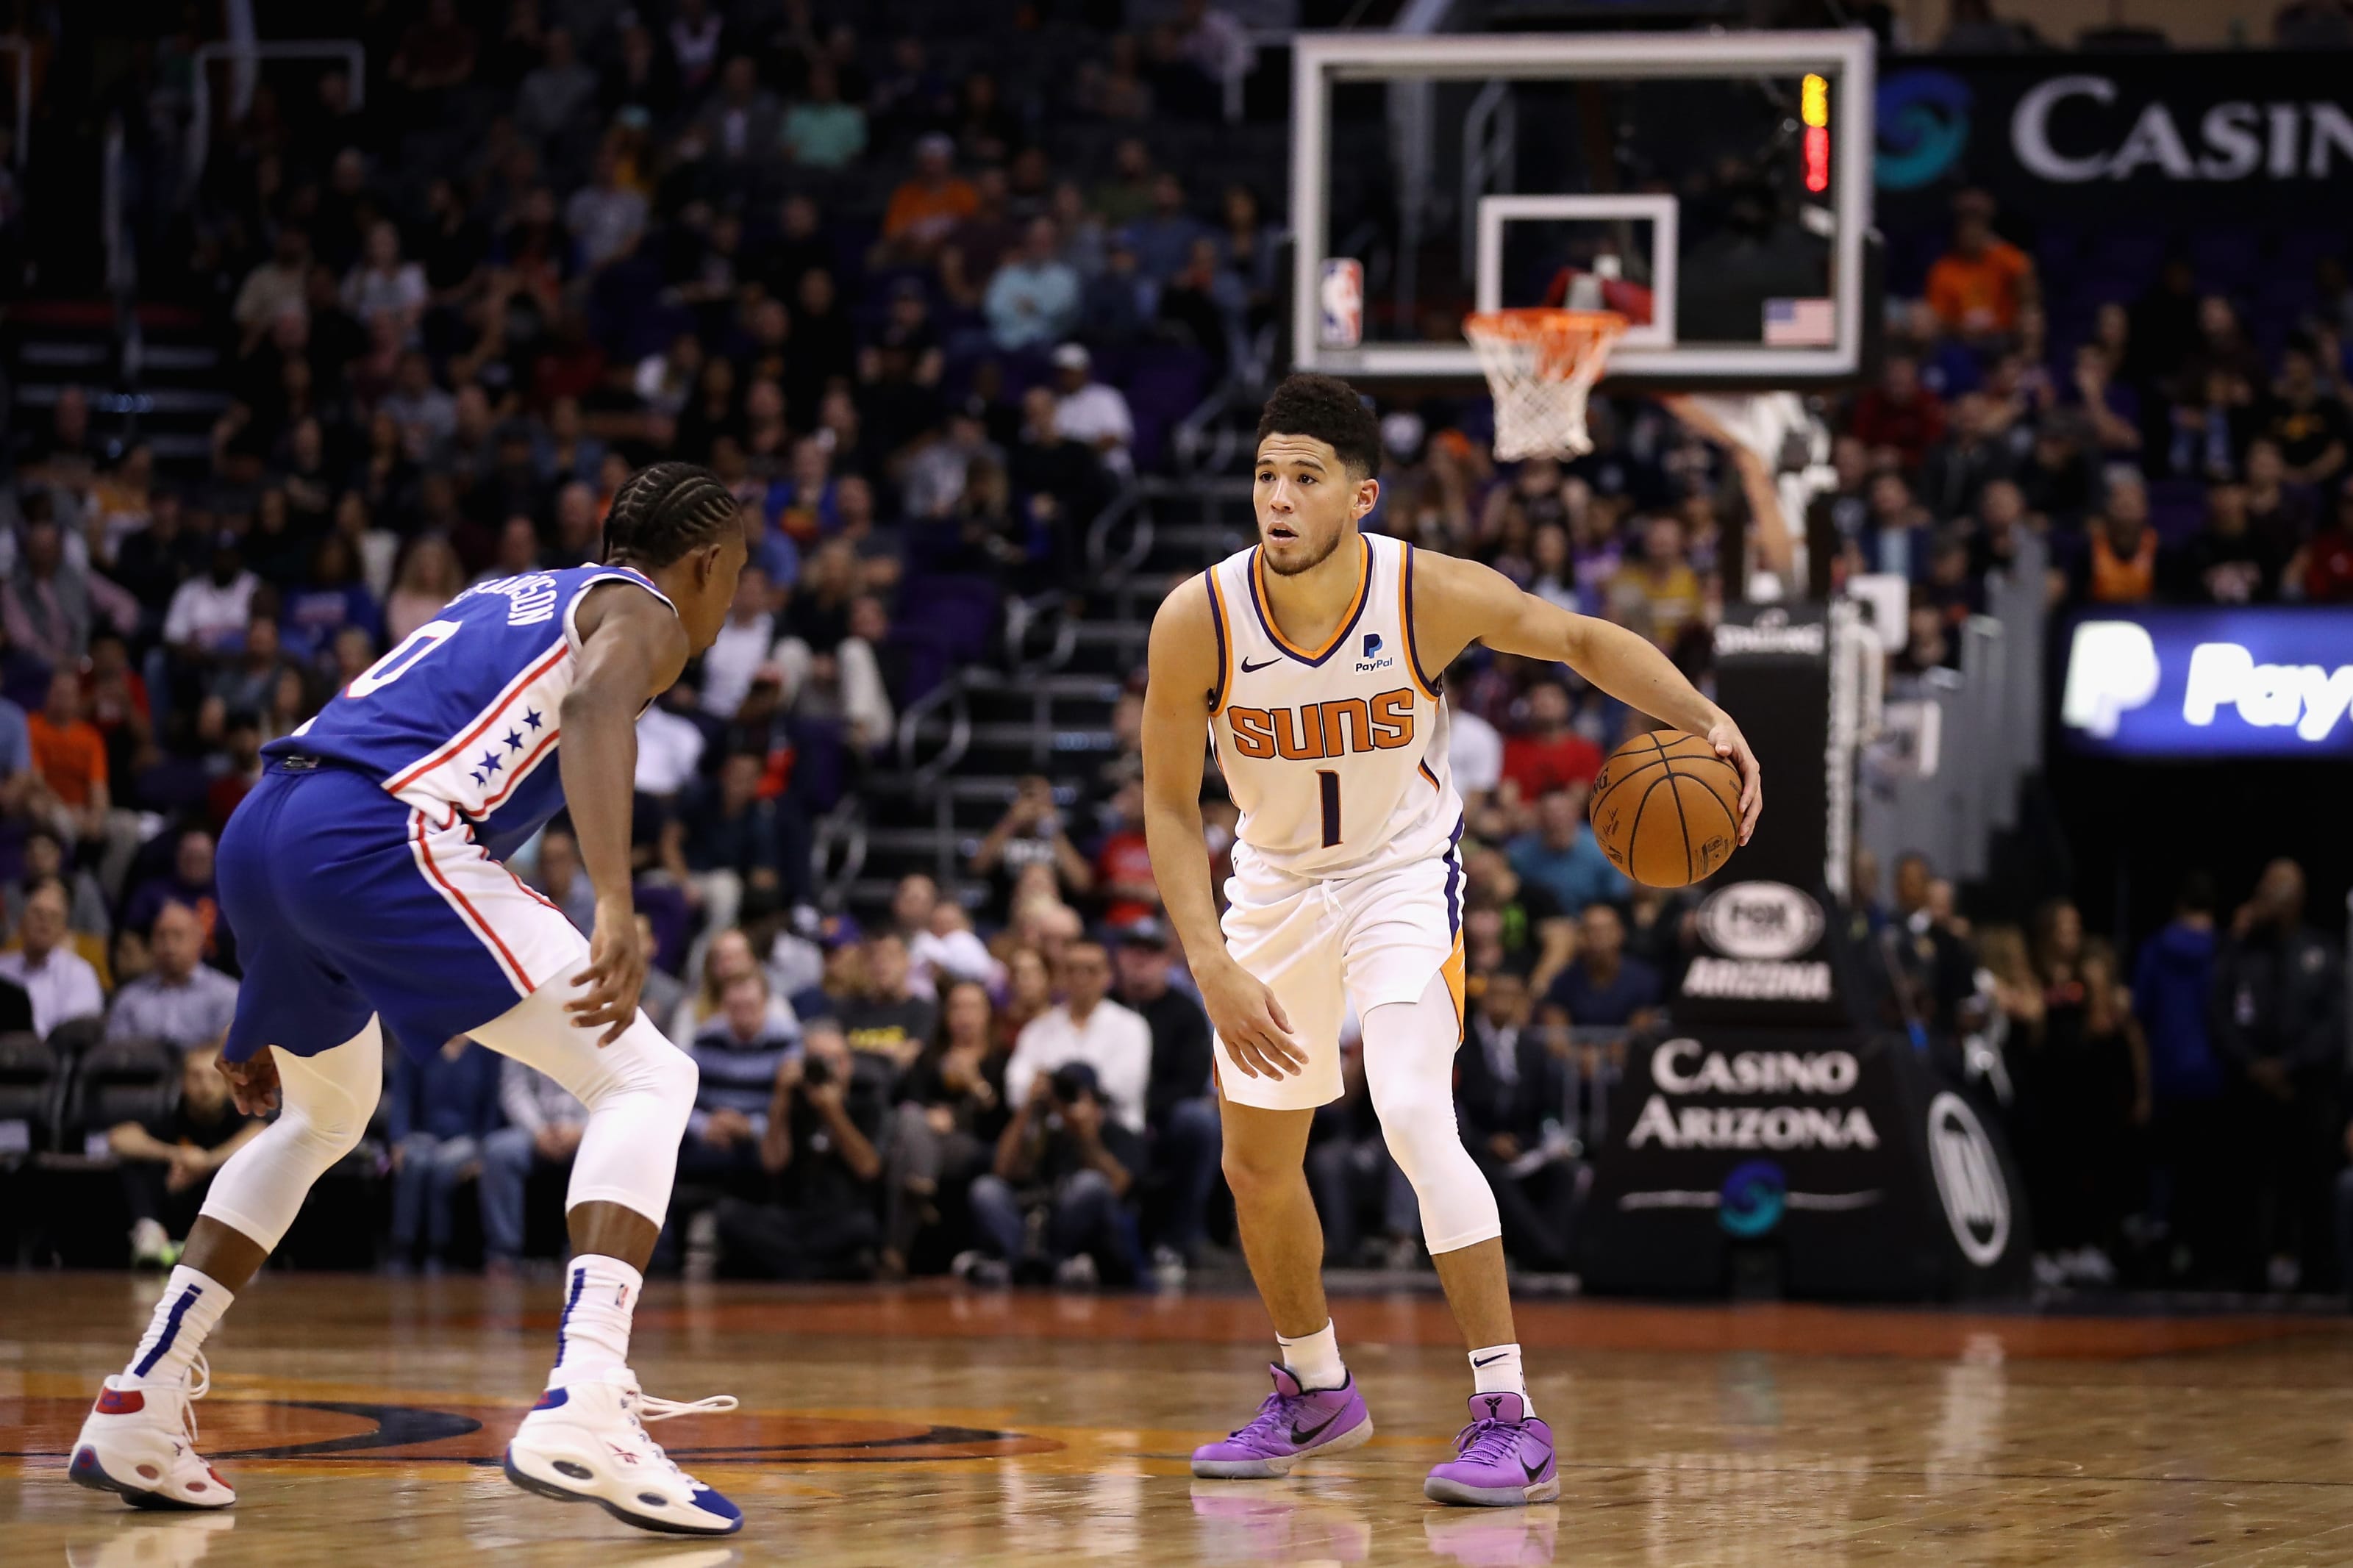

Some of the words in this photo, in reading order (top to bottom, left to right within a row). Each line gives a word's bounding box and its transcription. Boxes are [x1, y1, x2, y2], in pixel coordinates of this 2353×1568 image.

[1355, 657, 1393, 672] PayPal
[2183, 642, 2353, 741] Pay
[1228, 687, 1415, 760] SUNS
[1315, 769, 1343, 849] 1
[1682, 956, 1832, 1001] ARIZONA
[1650, 1037, 1859, 1095] CASINO
[1627, 1095, 1879, 1150] ARIZONA
